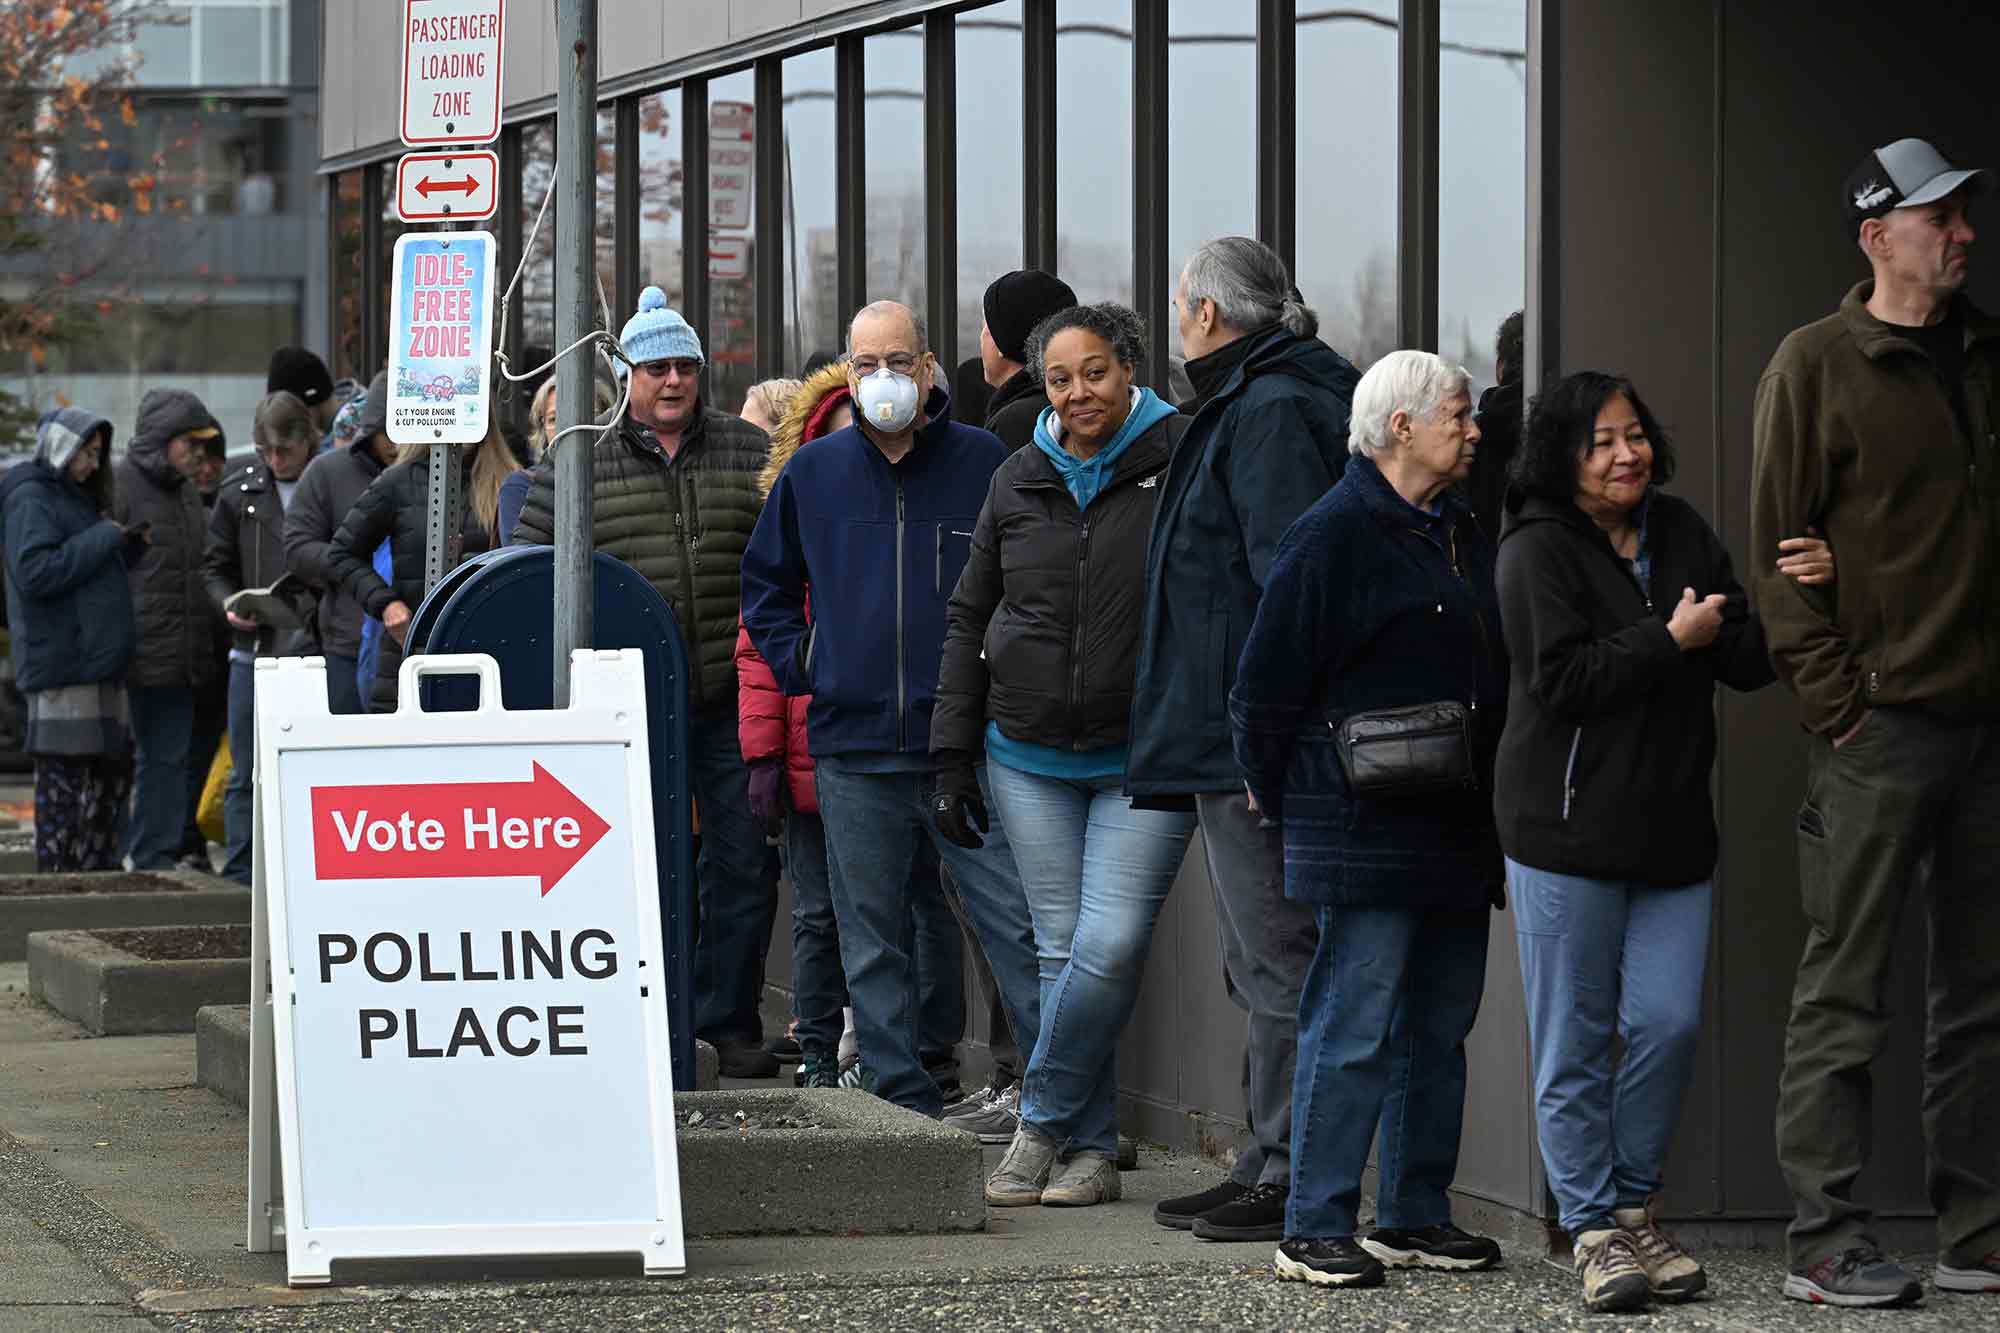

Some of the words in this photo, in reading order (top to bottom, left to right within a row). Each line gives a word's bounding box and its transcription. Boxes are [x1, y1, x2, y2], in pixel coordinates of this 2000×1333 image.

[411, 15, 497, 42] PASSENGER
[421, 53, 485, 80] LOADING
[432, 92, 471, 117] ZONE
[415, 254, 473, 287] IDLE-
[412, 289, 472, 322] FREE
[409, 326, 472, 358] ZONE
[402, 418, 415, 427] CUT
[416, 418, 457, 427] POLLUTION!
[410, 408, 430, 417] YOUR
[431, 408, 456, 417] ENGINE
[331, 809, 446, 853] Vote
[463, 806, 582, 850] Here
[317, 929, 619, 985] POLLING
[358, 1005, 589, 1060] PLACE
